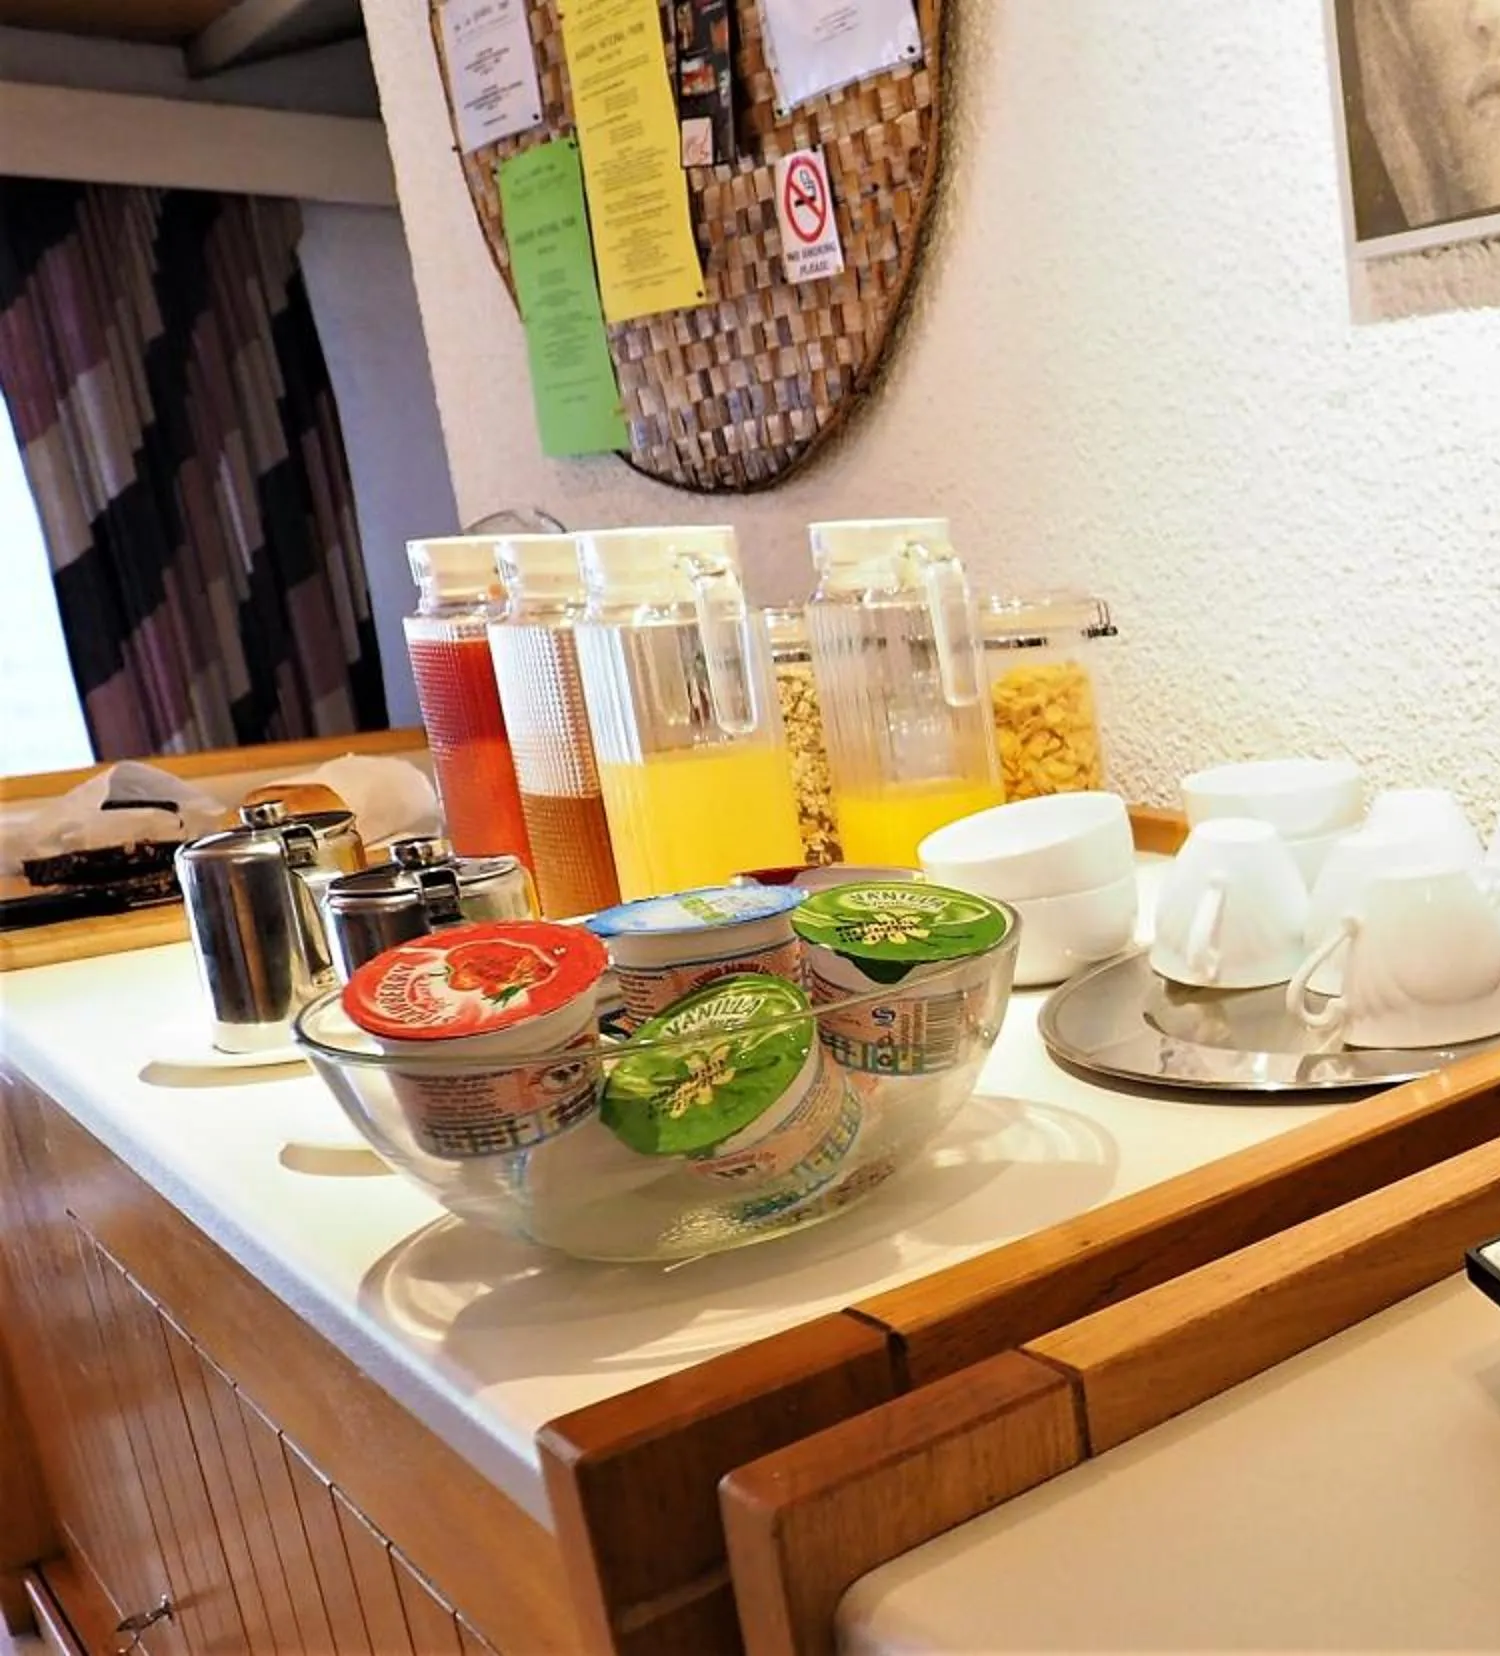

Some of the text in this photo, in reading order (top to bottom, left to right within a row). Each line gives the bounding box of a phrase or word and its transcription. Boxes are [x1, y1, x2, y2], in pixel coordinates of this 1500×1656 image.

[786, 242, 837, 262] NO SMOKING
[850, 889, 947, 910] VANILLA
[663, 995, 763, 1035] VANILLA
